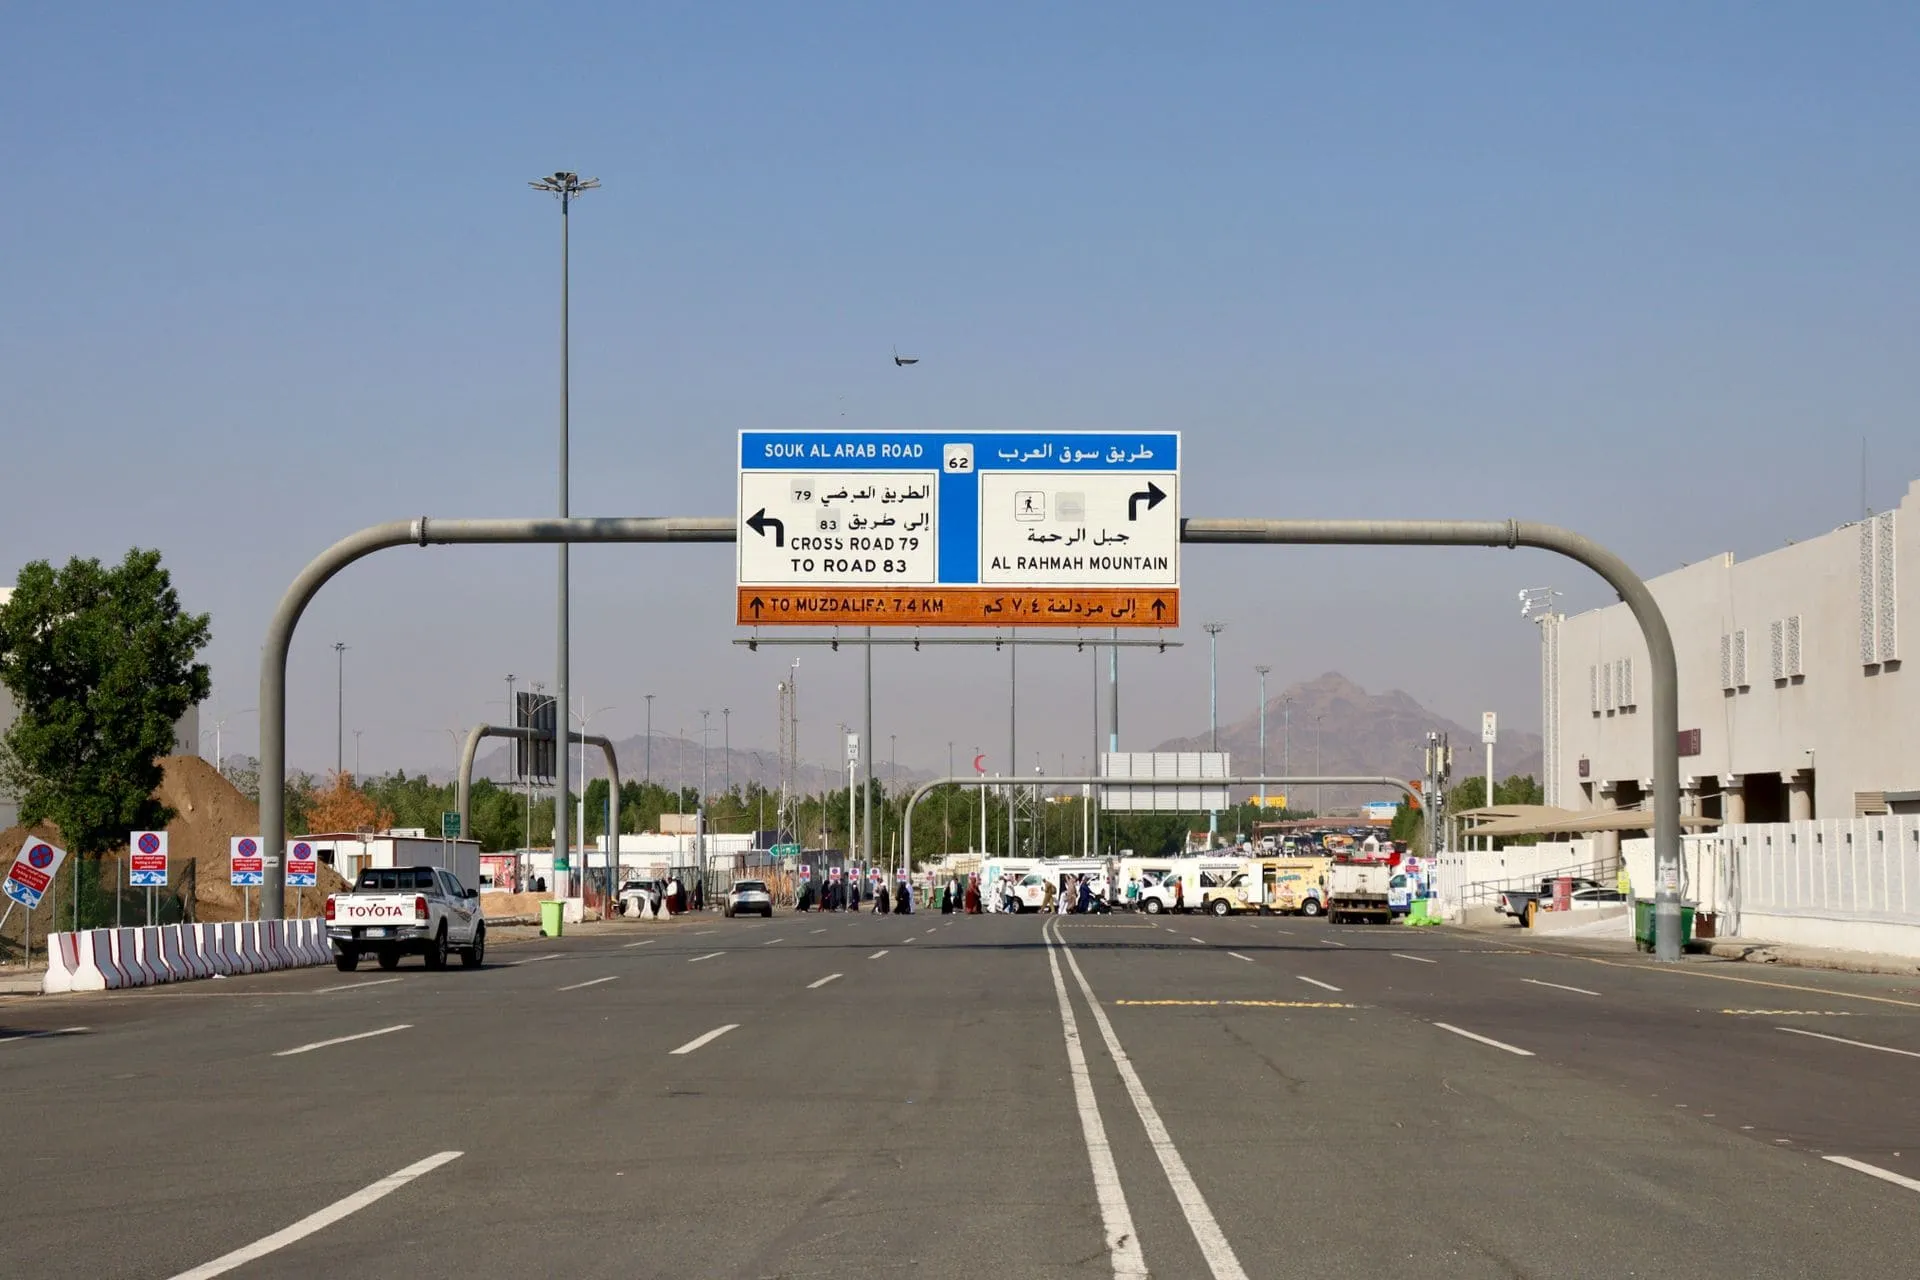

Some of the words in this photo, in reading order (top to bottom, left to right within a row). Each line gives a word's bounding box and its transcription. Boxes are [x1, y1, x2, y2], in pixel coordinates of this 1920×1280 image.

[765, 443, 804, 458] SOUK
[810, 443, 831, 458] AL
[834, 443, 876, 458] ARAB
[881, 443, 923, 458] ROAD
[998, 443, 1052, 463] العرب
[1059, 446, 1099, 463] سوق
[1106, 444, 1154, 464] طريق
[948, 457, 969, 469] 62
[794, 490, 812, 501] 79
[881, 485, 930, 504] الطريق
[820, 520, 837, 530] 83
[903, 512, 929, 532] إلى
[791, 537, 844, 551] CROSS
[850, 537, 895, 551] ROAD
[898, 537, 919, 551] 79
[1027, 527, 1086, 546] الرحمة
[1093, 528, 1130, 546] جبل
[791, 558, 815, 572] TO
[823, 558, 877, 572] ROAD
[883, 559, 907, 573] 83
[991, 556, 1011, 570] AL
[1017, 556, 1083, 570] RAHMAH
[1089, 556, 1168, 570] MOUNTAIN
[770, 597, 790, 612] TO
[796, 598, 886, 613] MUZDALIFA
[893, 598, 917, 613] 7.4
[922, 598, 944, 613] KM
[983, 597, 1004, 617] كم
[1048, 597, 1104, 617] مزدلفة
[1111, 597, 1136, 618] إلى
[347, 906, 404, 917] TOYOTA
